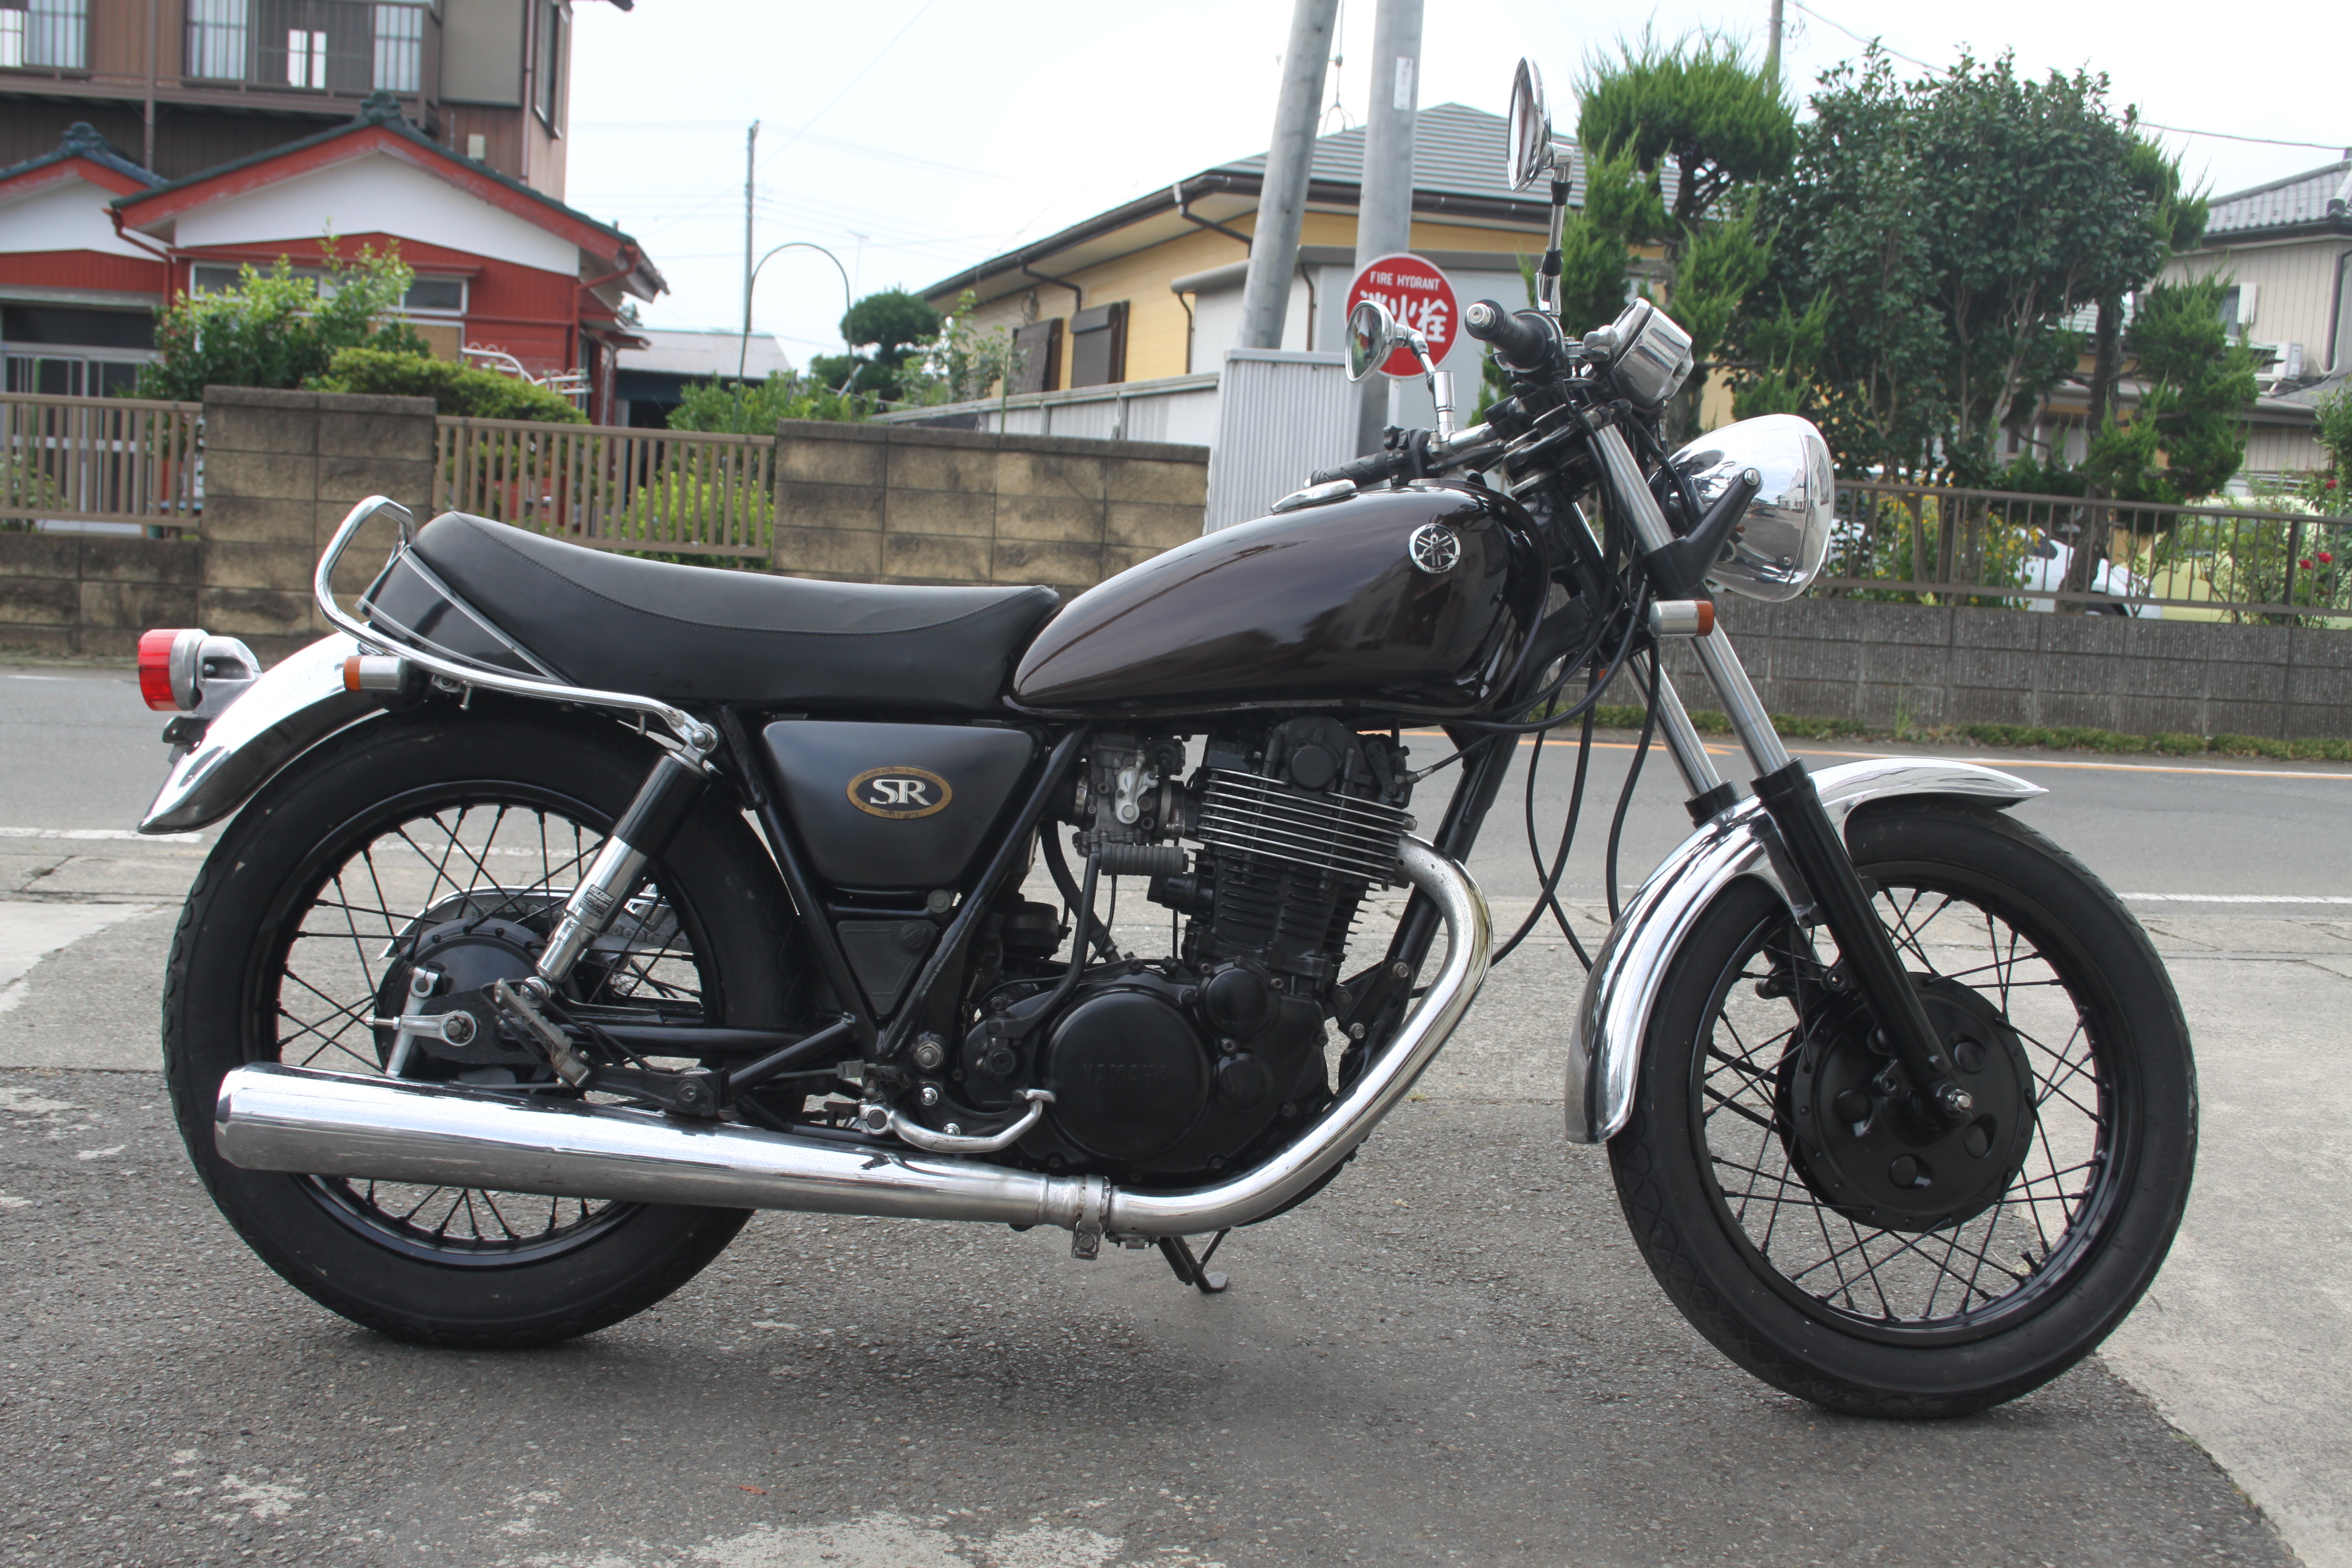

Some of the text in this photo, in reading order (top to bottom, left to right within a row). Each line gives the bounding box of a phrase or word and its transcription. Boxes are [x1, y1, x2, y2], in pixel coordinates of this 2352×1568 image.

[1370, 271, 1441, 291] FIRE HYDRANT
[870, 778, 932, 806] SR
[589, 885, 614, 902] DAYTONA
